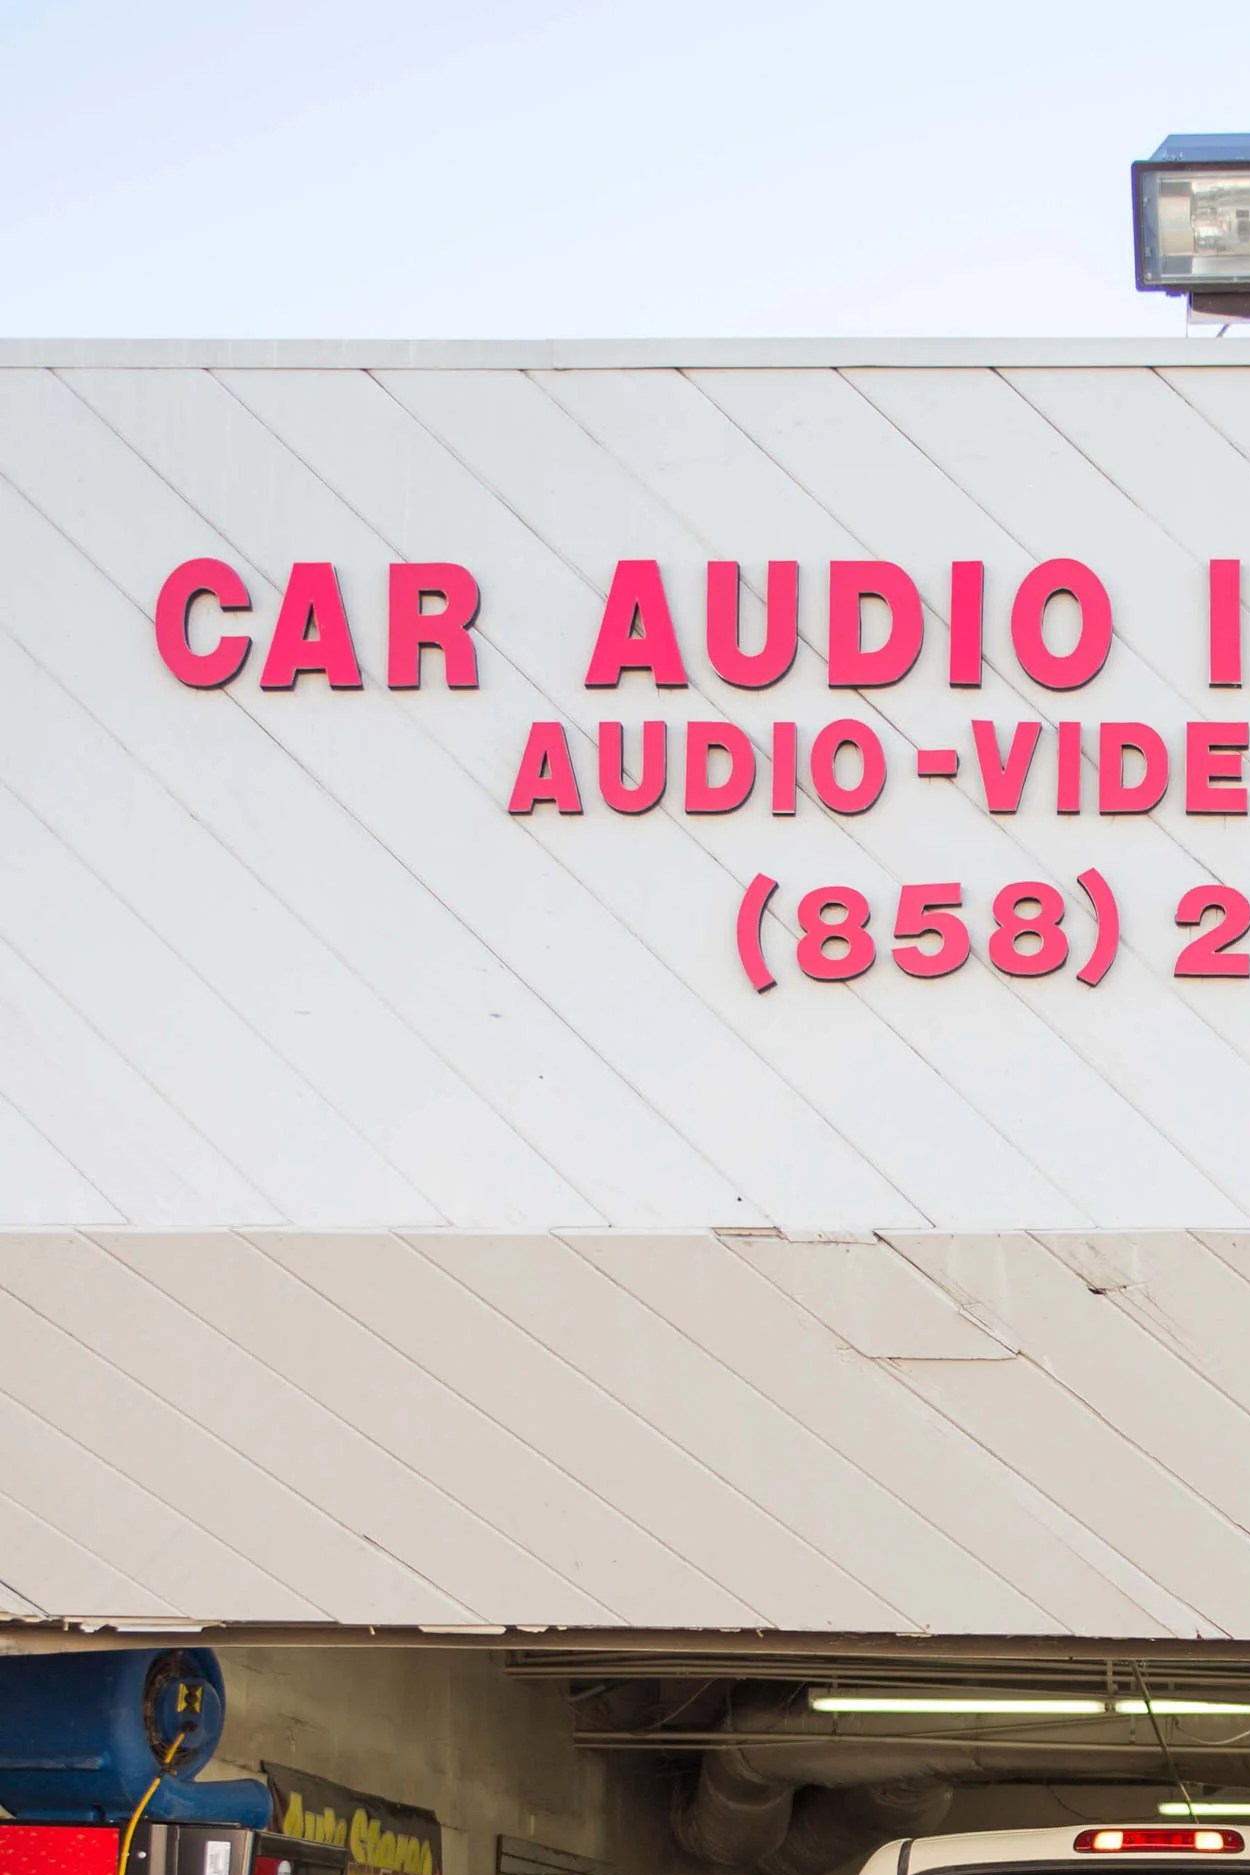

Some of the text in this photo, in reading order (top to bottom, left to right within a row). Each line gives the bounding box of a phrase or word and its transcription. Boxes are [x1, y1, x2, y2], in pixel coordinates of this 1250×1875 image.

[154, 556, 481, 692] CAR
[583, 557, 1114, 690] AUDIO
[735, 867, 1121, 992] (858)
